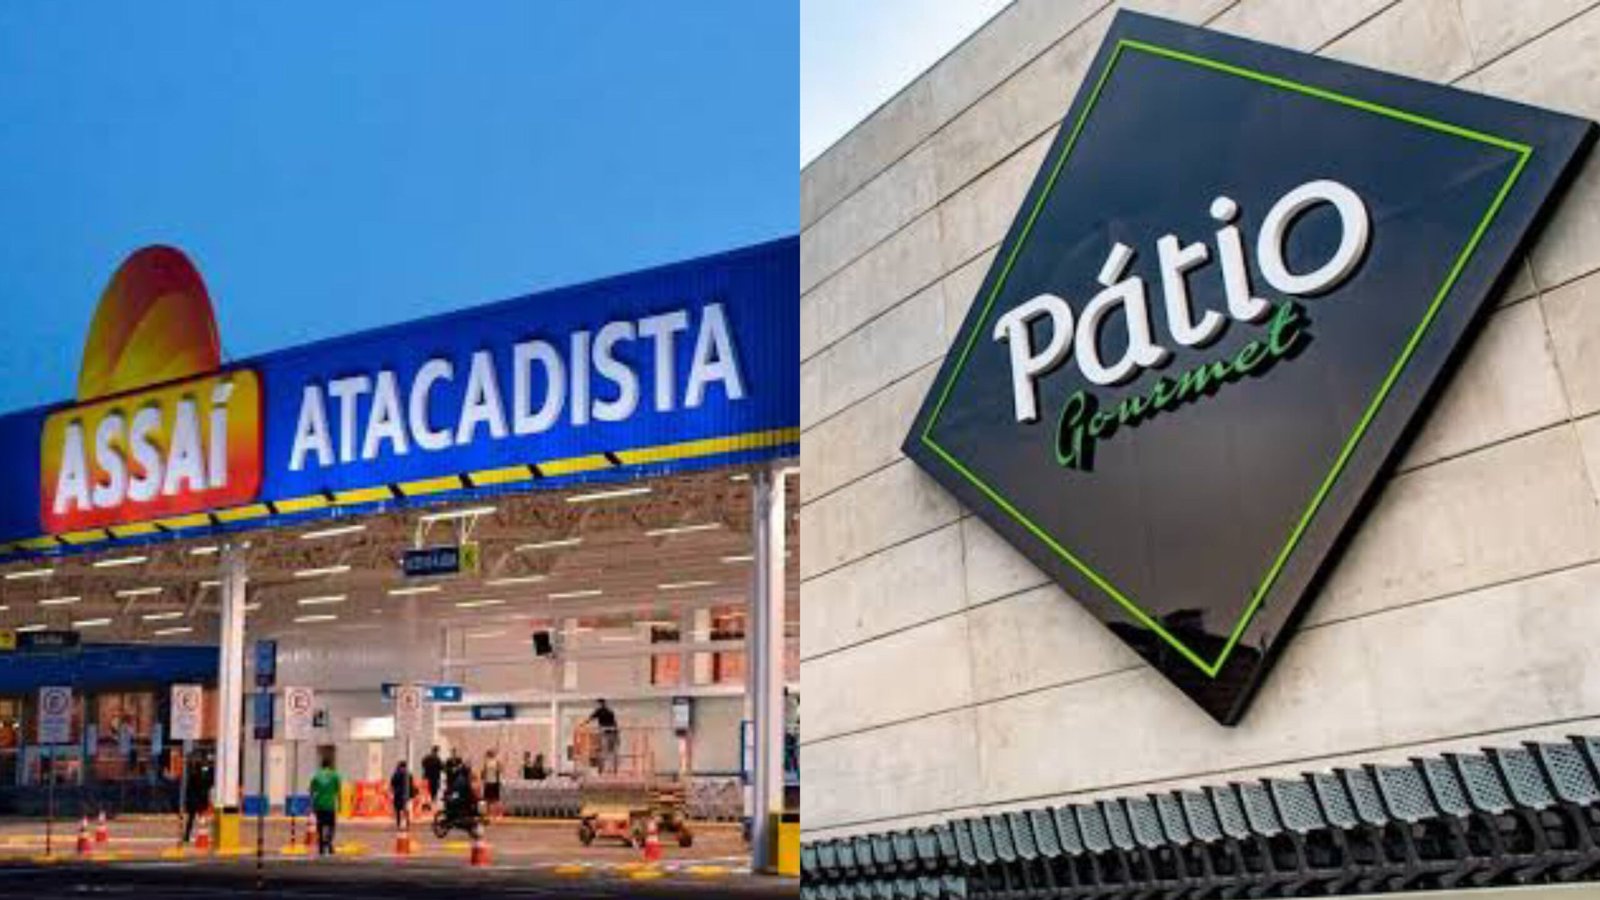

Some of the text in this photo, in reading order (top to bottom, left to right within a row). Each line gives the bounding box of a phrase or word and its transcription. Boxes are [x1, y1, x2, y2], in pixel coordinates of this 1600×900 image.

[993, 180, 1371, 422] Pátio
[1054, 299, 1302, 469] Gourmet
[290, 303, 746, 470] ATACADISTA
